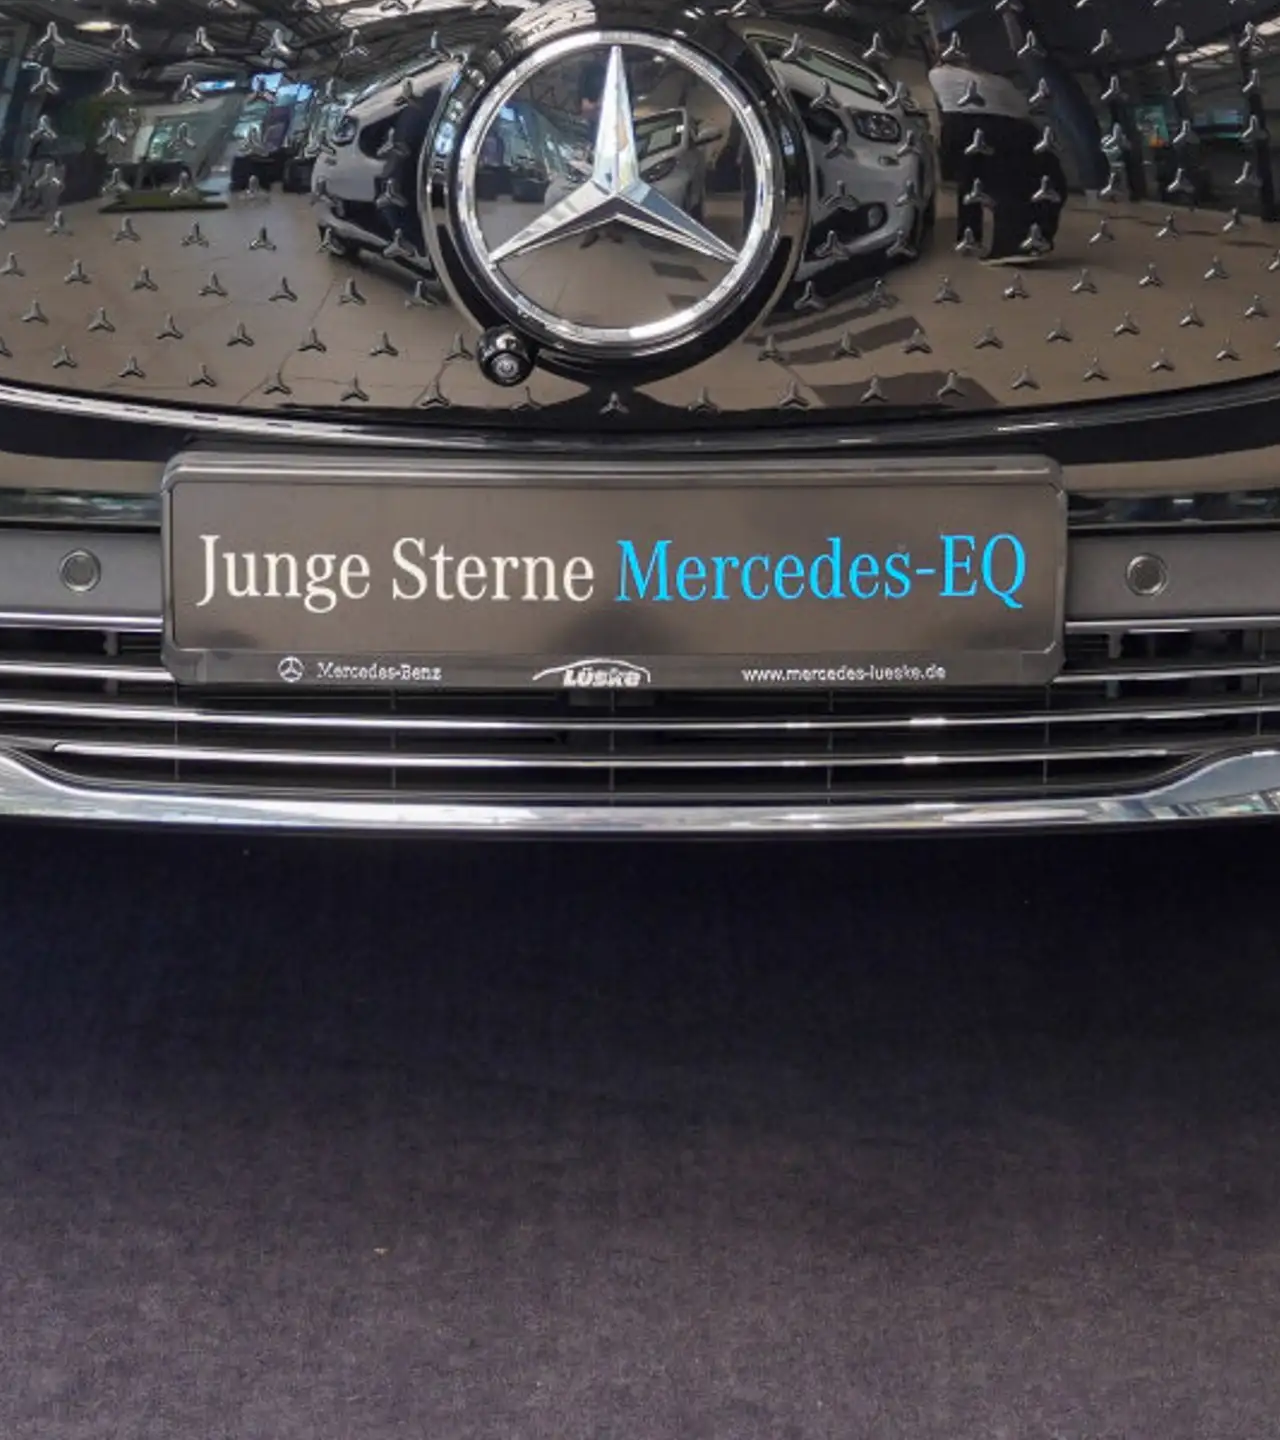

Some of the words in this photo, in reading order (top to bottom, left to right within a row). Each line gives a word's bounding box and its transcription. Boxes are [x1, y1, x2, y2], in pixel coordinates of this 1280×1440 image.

[195, 535, 371, 613] Junge
[391, 537, 595, 602] Sterne
[615, 531, 1028, 609] Mercedes-EQ
[316, 661, 443, 681] Mercedes-Benz
[740, 664, 947, 681] www.mercedes-lueske.de
